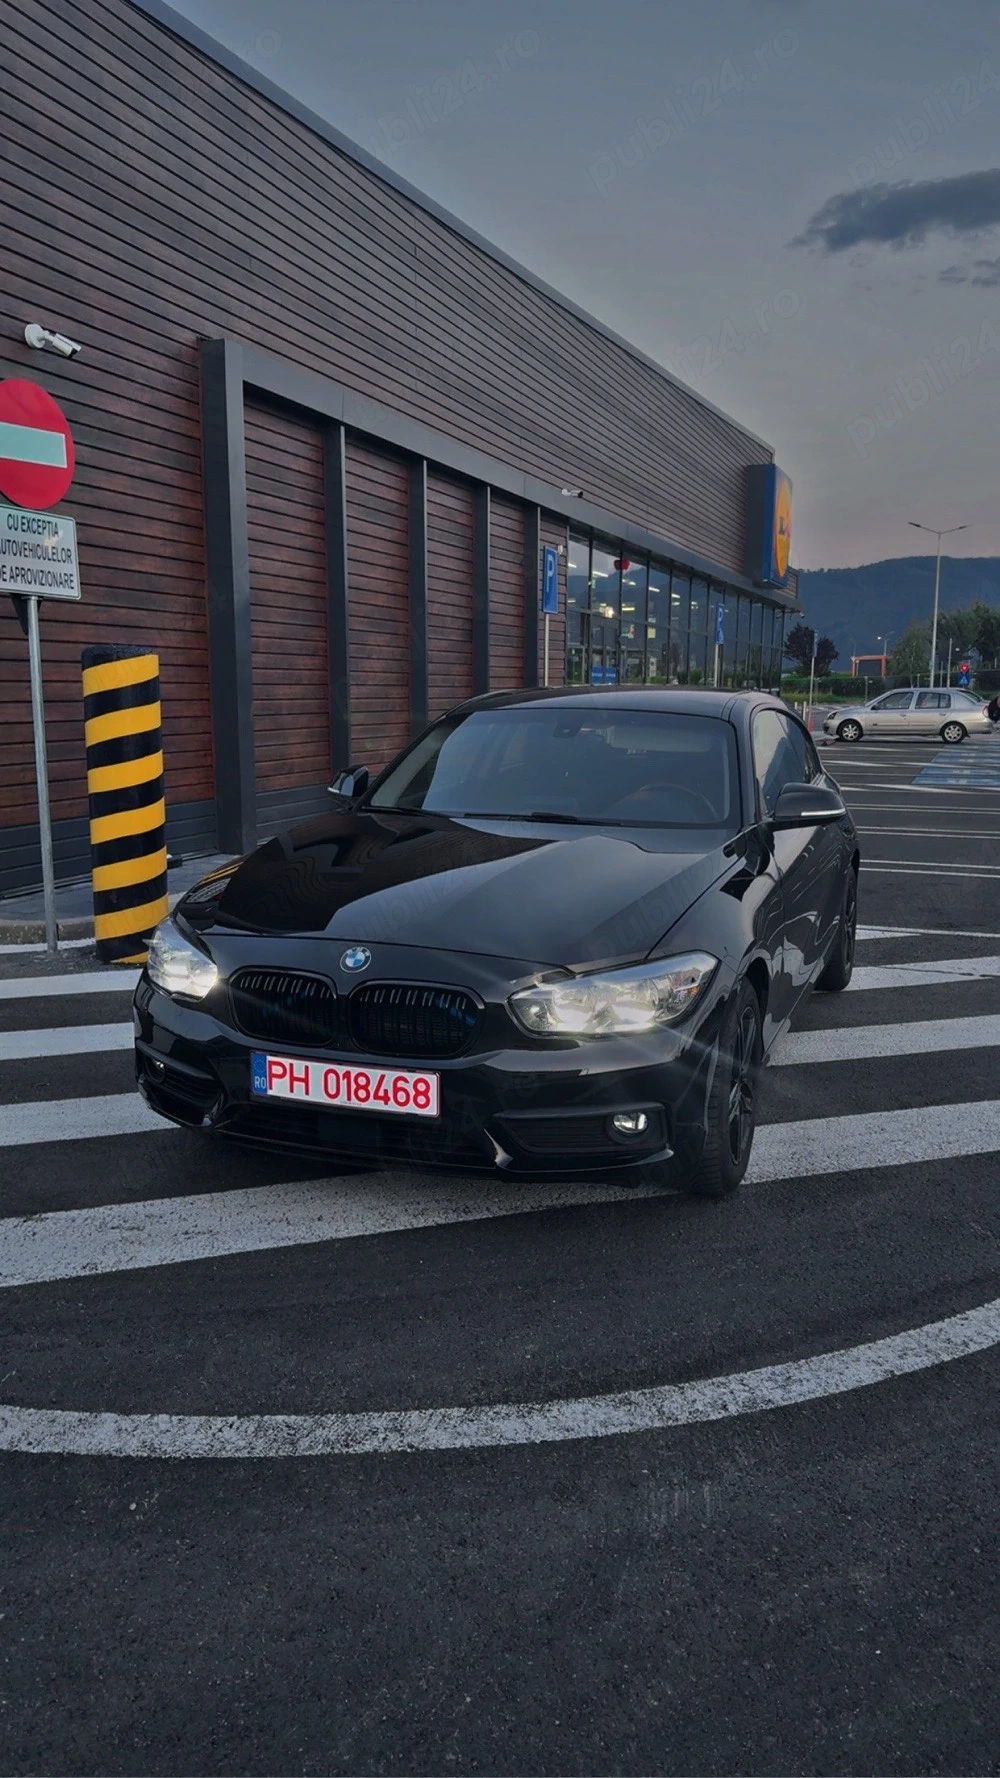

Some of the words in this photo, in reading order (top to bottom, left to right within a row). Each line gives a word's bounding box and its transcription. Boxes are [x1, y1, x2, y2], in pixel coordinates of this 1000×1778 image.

[7, 513, 19, 532] CU
[0, 538, 73, 564] UTOVEHICULELOR
[0, 565, 7, 582] E
[9, 566, 75, 590] APROVIZIONARE
[546, 554, 555, 592] P
[254, 1075, 267, 1090] RO
[268, 1060, 310, 1096] PH
[323, 1068, 431, 1109] 018468
